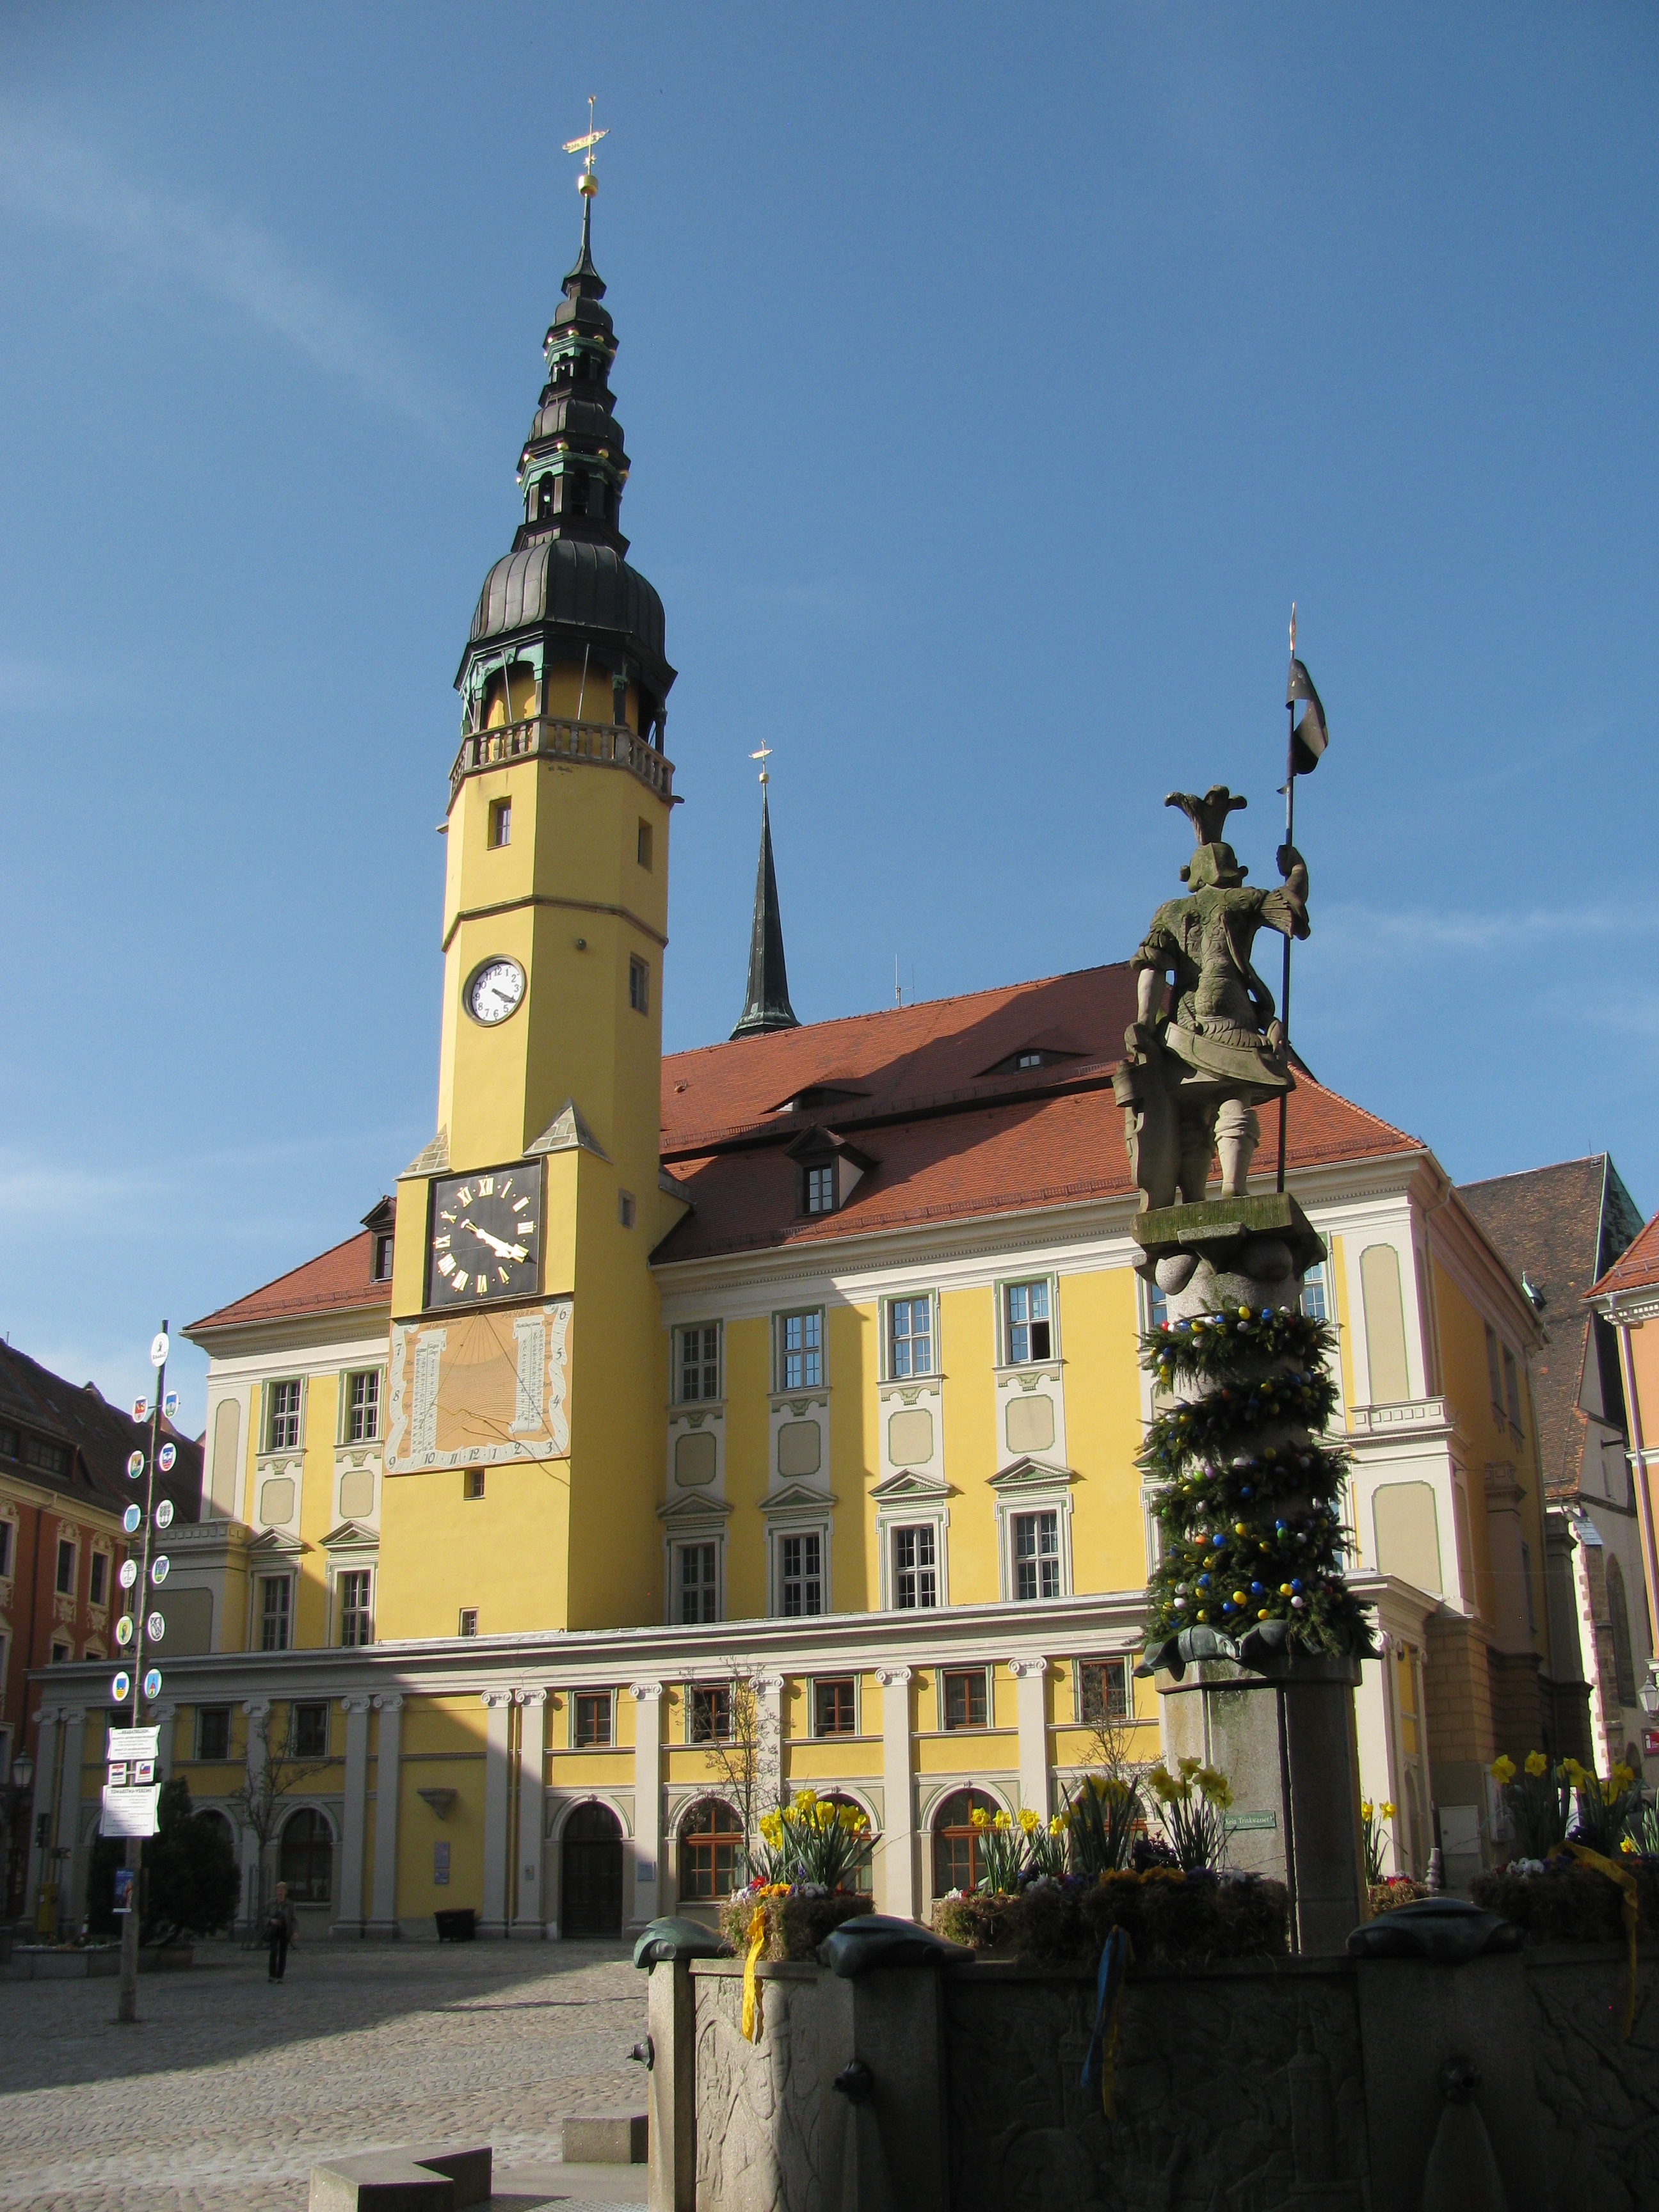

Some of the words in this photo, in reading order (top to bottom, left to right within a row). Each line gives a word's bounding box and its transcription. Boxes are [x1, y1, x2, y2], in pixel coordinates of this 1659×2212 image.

[494, 967, 502, 976] 12
[511, 974, 517, 982] 2
[479, 981, 486, 990] 10
[514, 984, 519, 993] 3
[478, 1002, 483, 1011] 8
[485, 1009, 490, 1017] 7
[504, 1004, 509, 1013] 5
[478, 1177, 494, 1198] XII
[501, 1181, 512, 1198] I
[457, 1186, 474, 1208] XI
[513, 1197, 529, 1212] II
[441, 1210, 458, 1224] X
[517, 1221, 534, 1235] III
[435, 1234, 451, 1249] IX
[498, 1266, 509, 1284] V
[477, 1274, 488, 1294] VI
[559, 1307, 566, 1320] 6
[396, 1343, 402, 1356] 7
[556, 1347, 563, 1359] 5
[393, 1390, 400, 1401] 8
[552, 1395, 559, 1409] 4
[492, 1448, 497, 1459] 1
[514, 1442, 522, 1455] 2
[545, 1441, 553, 1454] 3
[424, 1452, 435, 1464] 10
[450, 1452, 458, 1464] 11
[469, 1448, 480, 1461] 12
[389, 1456, 396, 1469] 9
